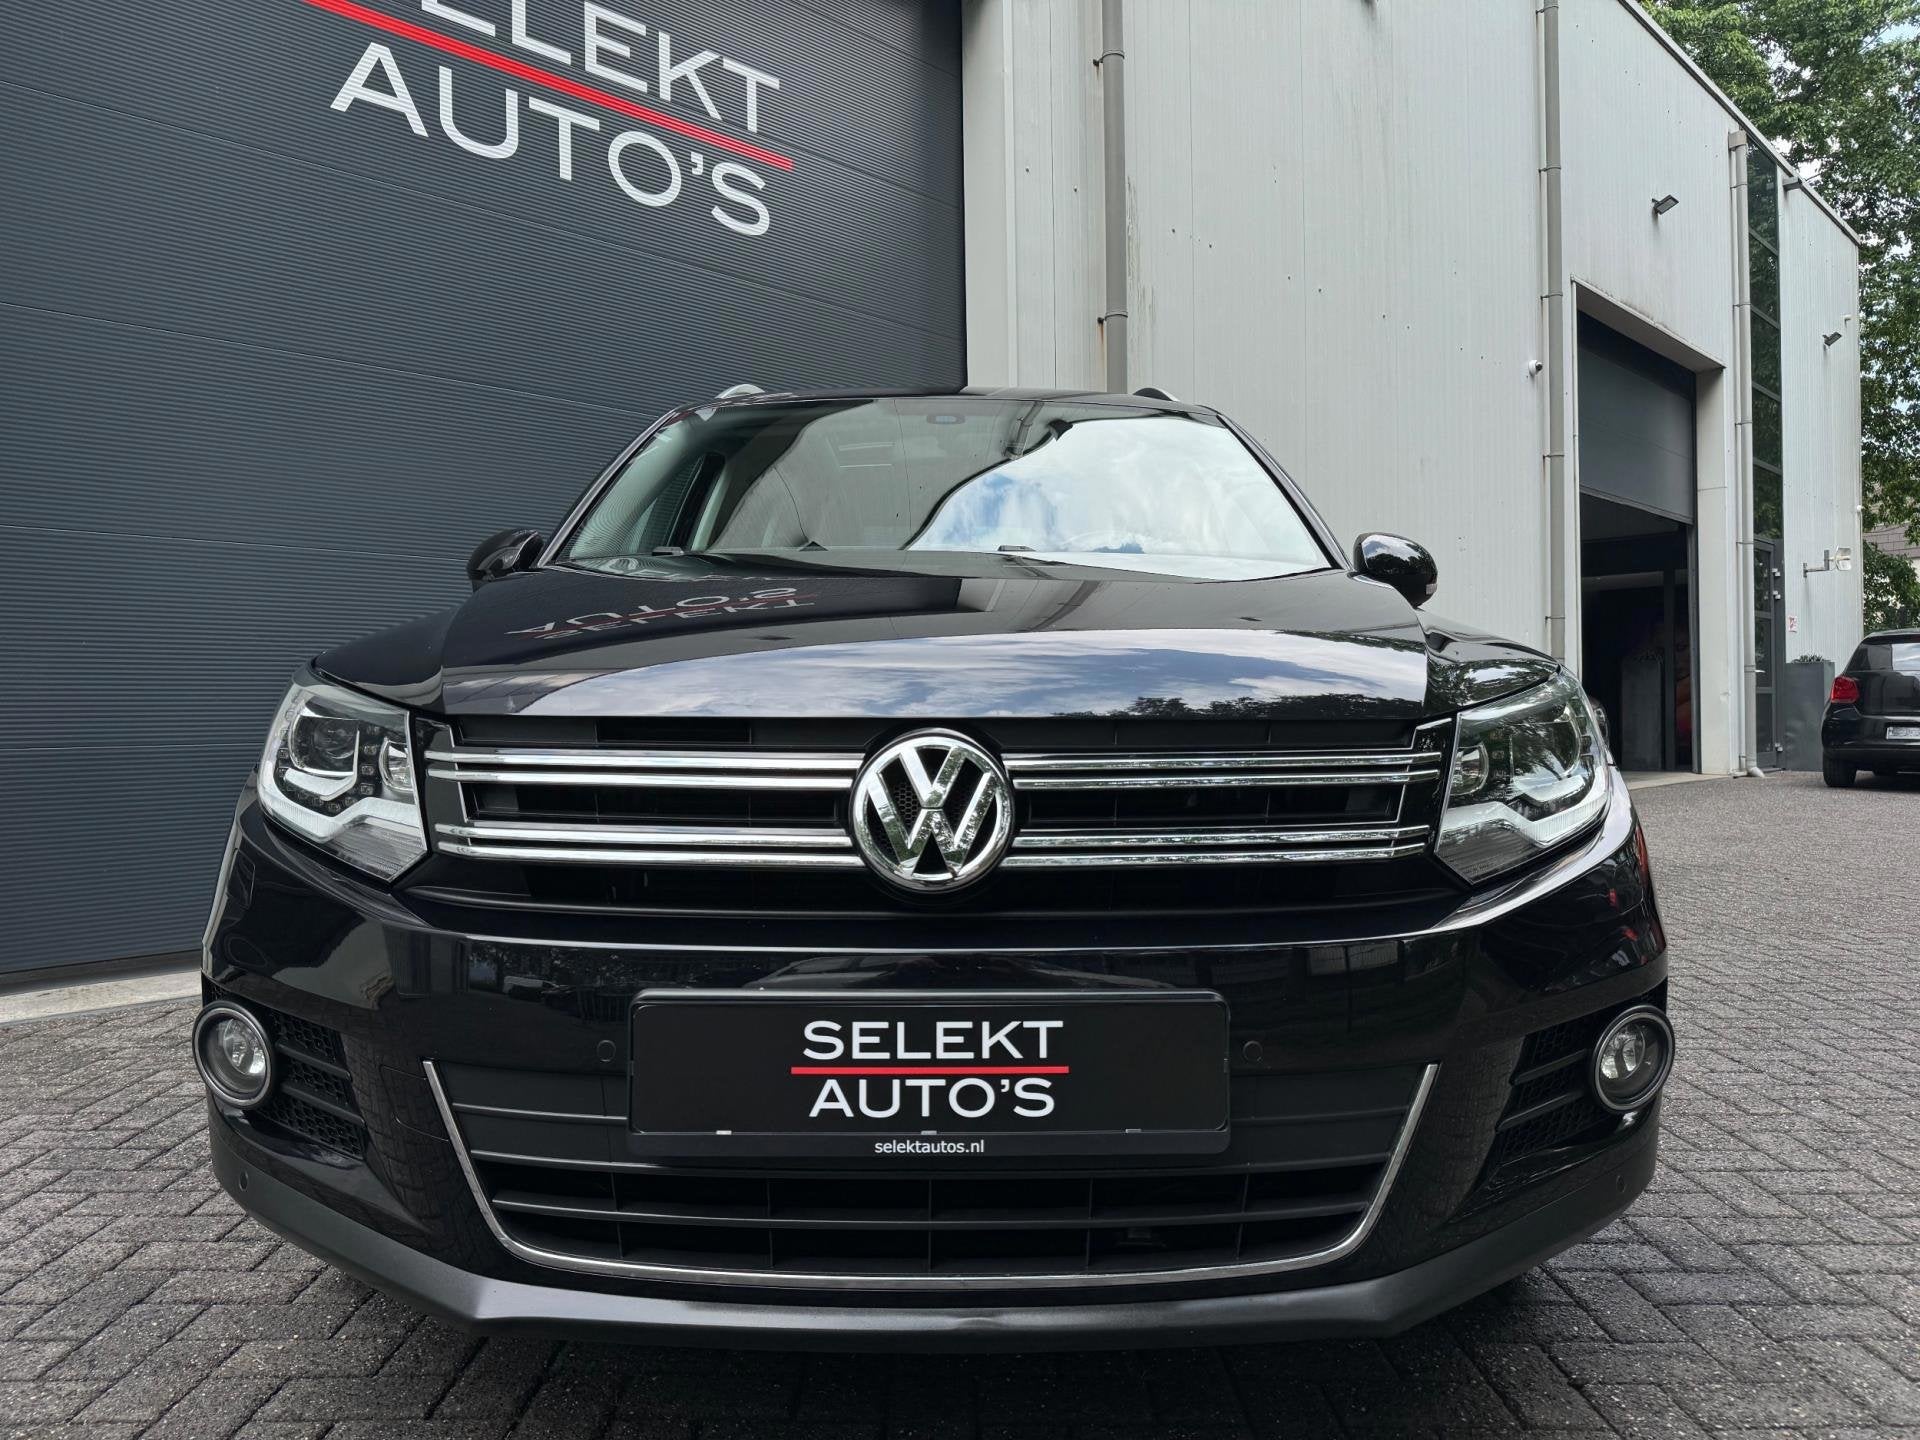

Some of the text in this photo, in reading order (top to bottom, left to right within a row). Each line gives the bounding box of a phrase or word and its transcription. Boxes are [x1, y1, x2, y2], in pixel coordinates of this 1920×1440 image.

[330, 41, 771, 236] AUTO'S
[803, 1020, 1064, 1060] SELEKT
[808, 1077, 1055, 1118] AUTO'S
[874, 1139, 984, 1154] selektautos.nl
